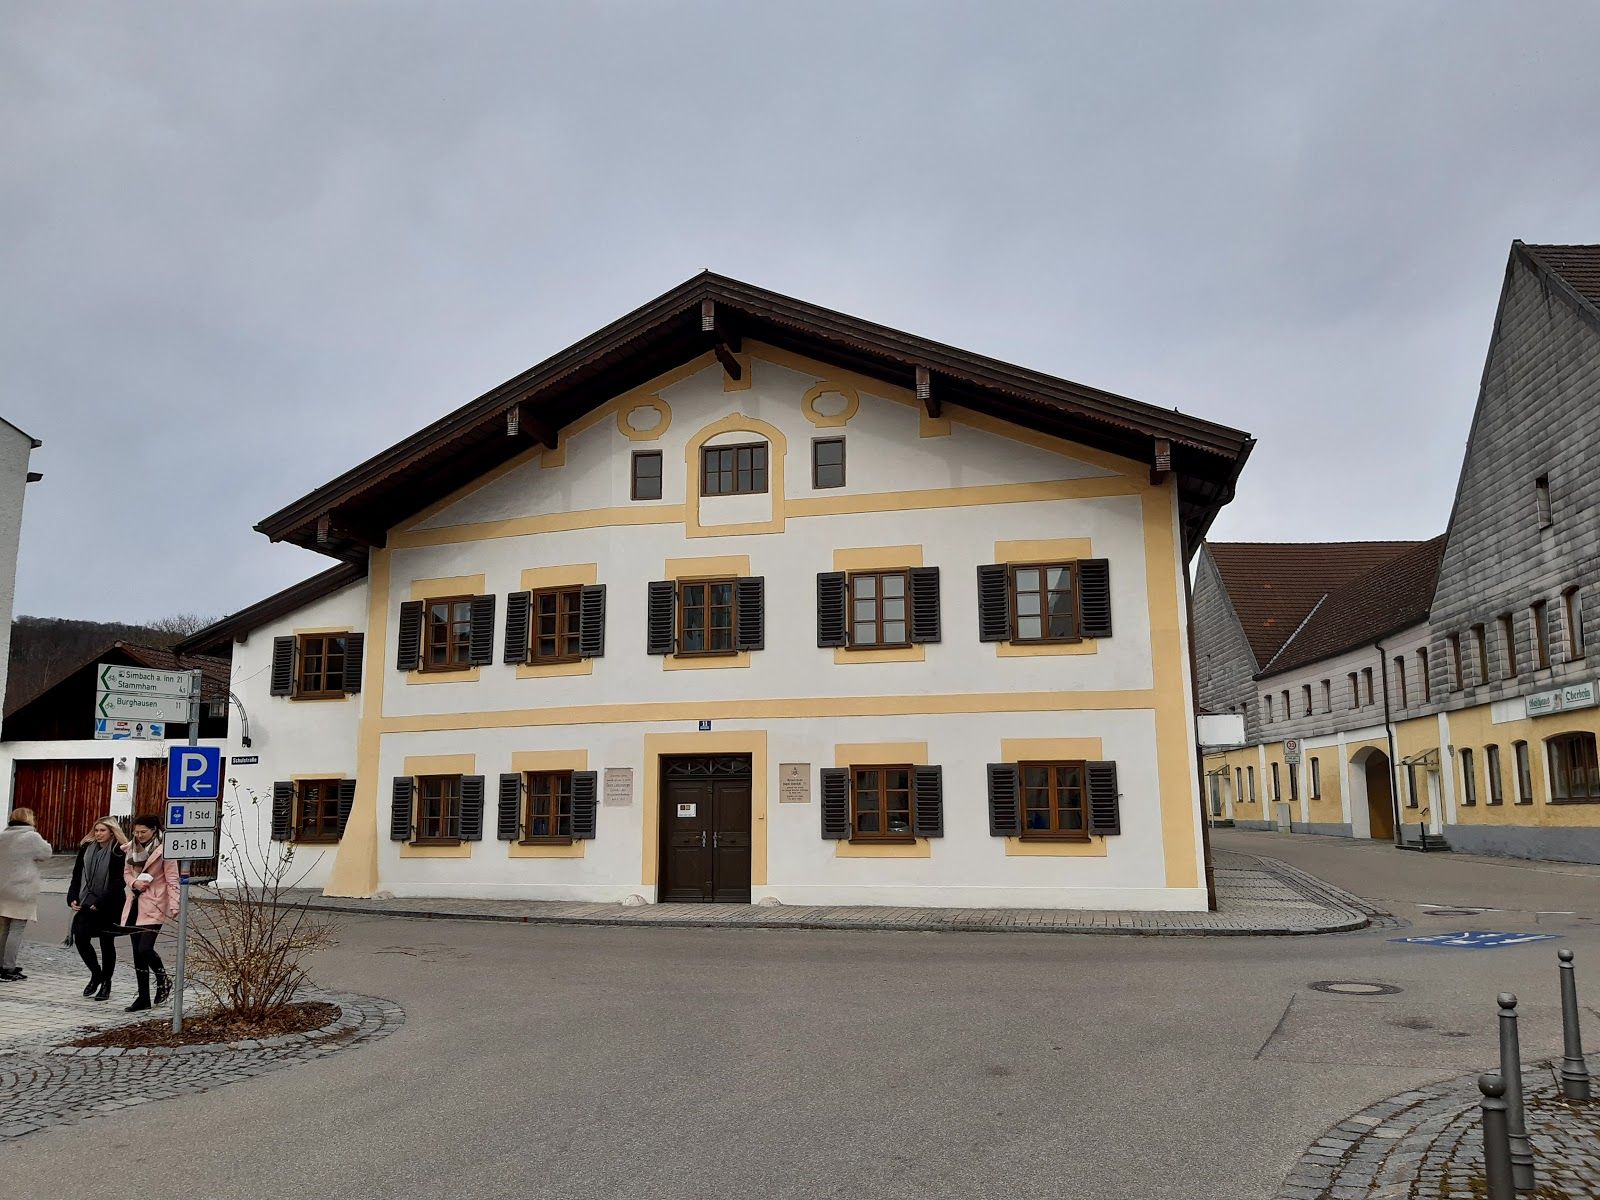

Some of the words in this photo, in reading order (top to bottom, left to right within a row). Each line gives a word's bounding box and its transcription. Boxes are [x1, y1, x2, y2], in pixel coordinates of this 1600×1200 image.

[126, 671, 155, 681] Simbach
[177, 675, 183, 683] 21
[118, 680, 157, 691] Stammham
[116, 697, 157, 707] Burghausen
[180, 753, 208, 791] P
[189, 811, 193, 819] 1
[195, 811, 212, 819] Std.
[172, 839, 198, 850] 8-18
[200, 838, 206, 850] h
